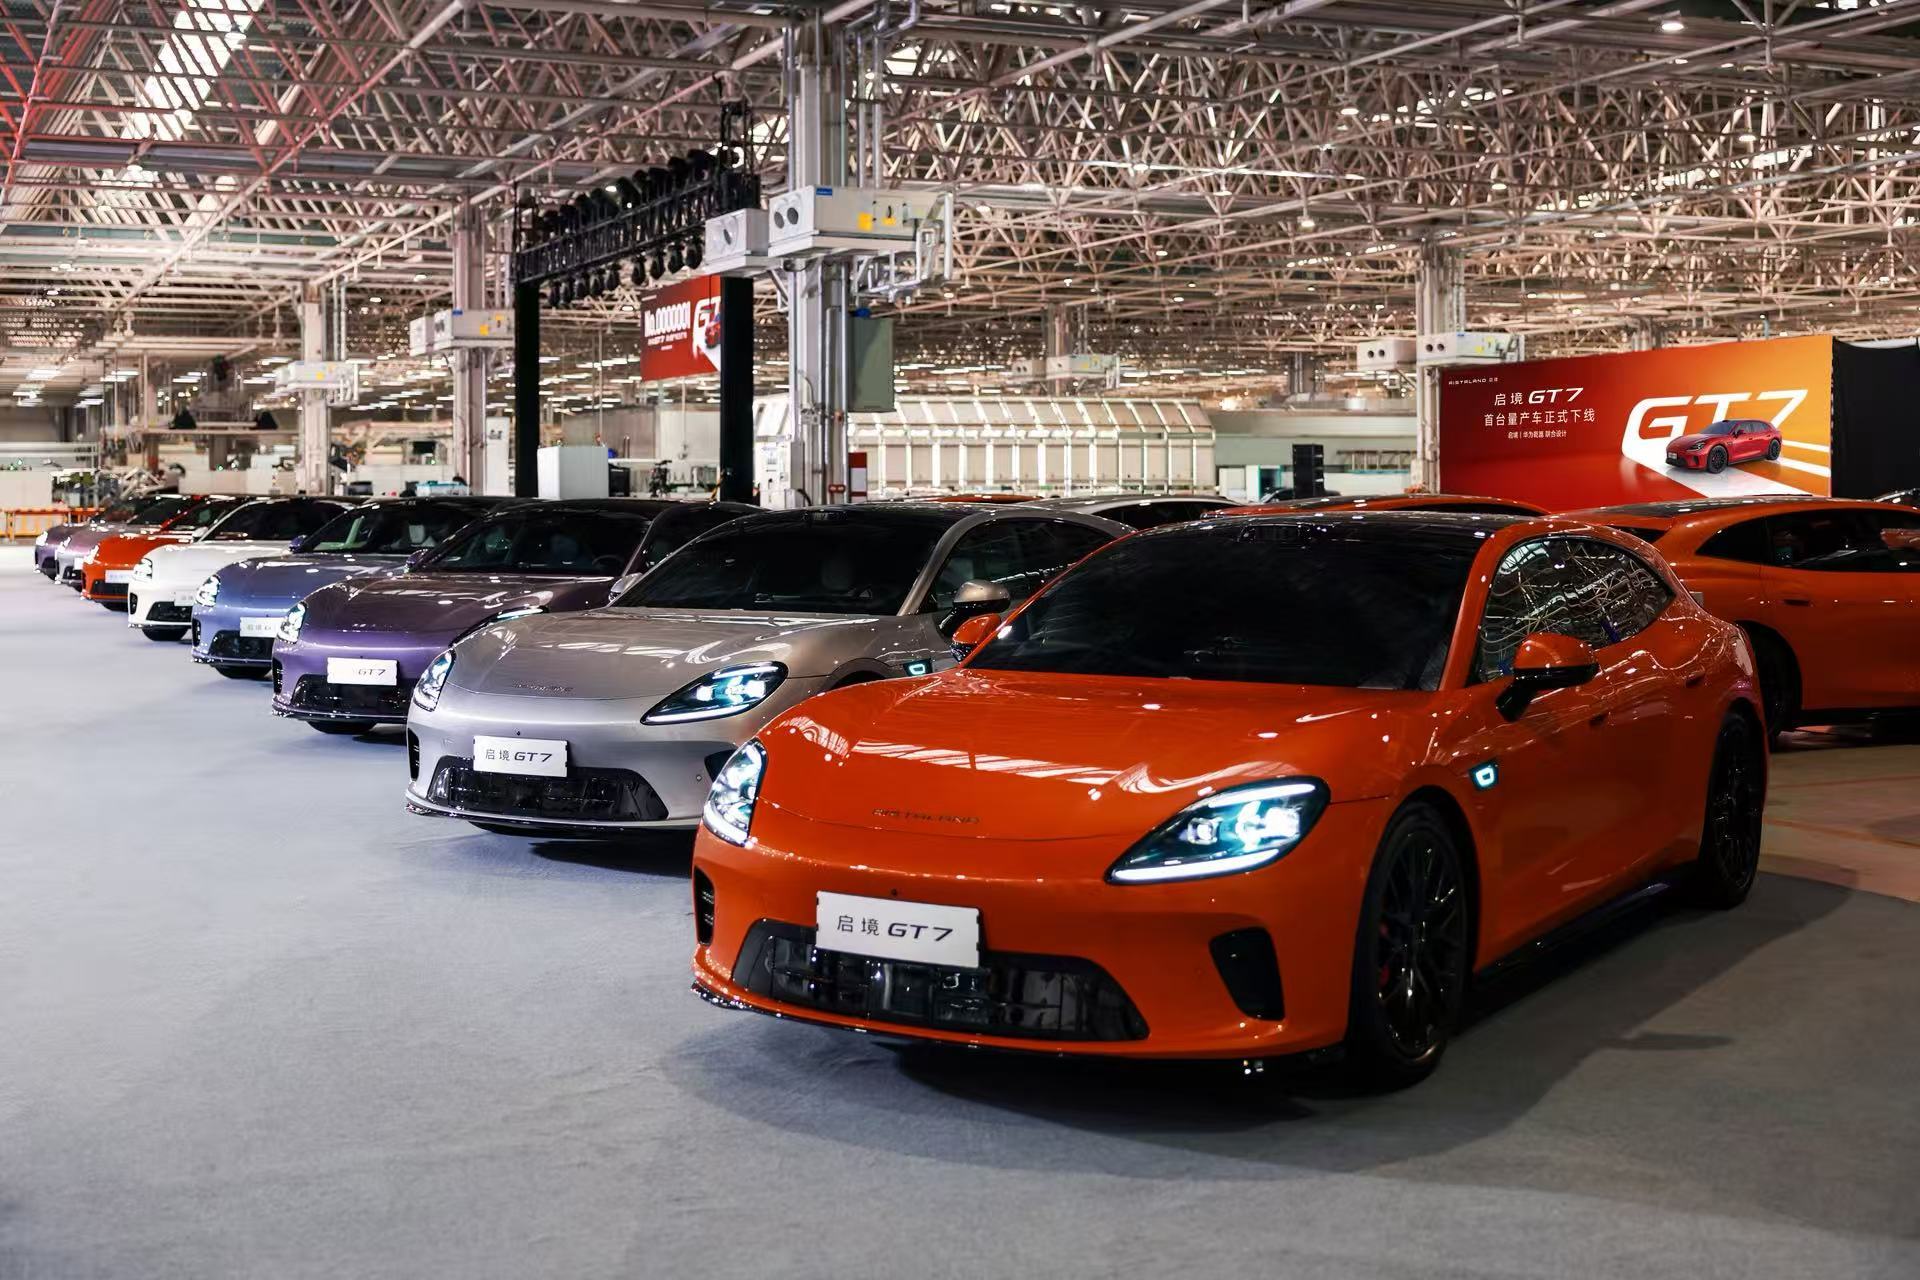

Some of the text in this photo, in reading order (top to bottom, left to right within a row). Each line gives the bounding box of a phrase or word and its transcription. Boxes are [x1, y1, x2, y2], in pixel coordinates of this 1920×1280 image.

[1494, 387, 1584, 406] 启境 GT7
[1484, 408, 1595, 427] 首台量产车正式下线
[1621, 389, 1808, 458] GT7
[485, 748, 553, 763] 启境 GT7
[837, 915, 953, 942] 启境 GT7
